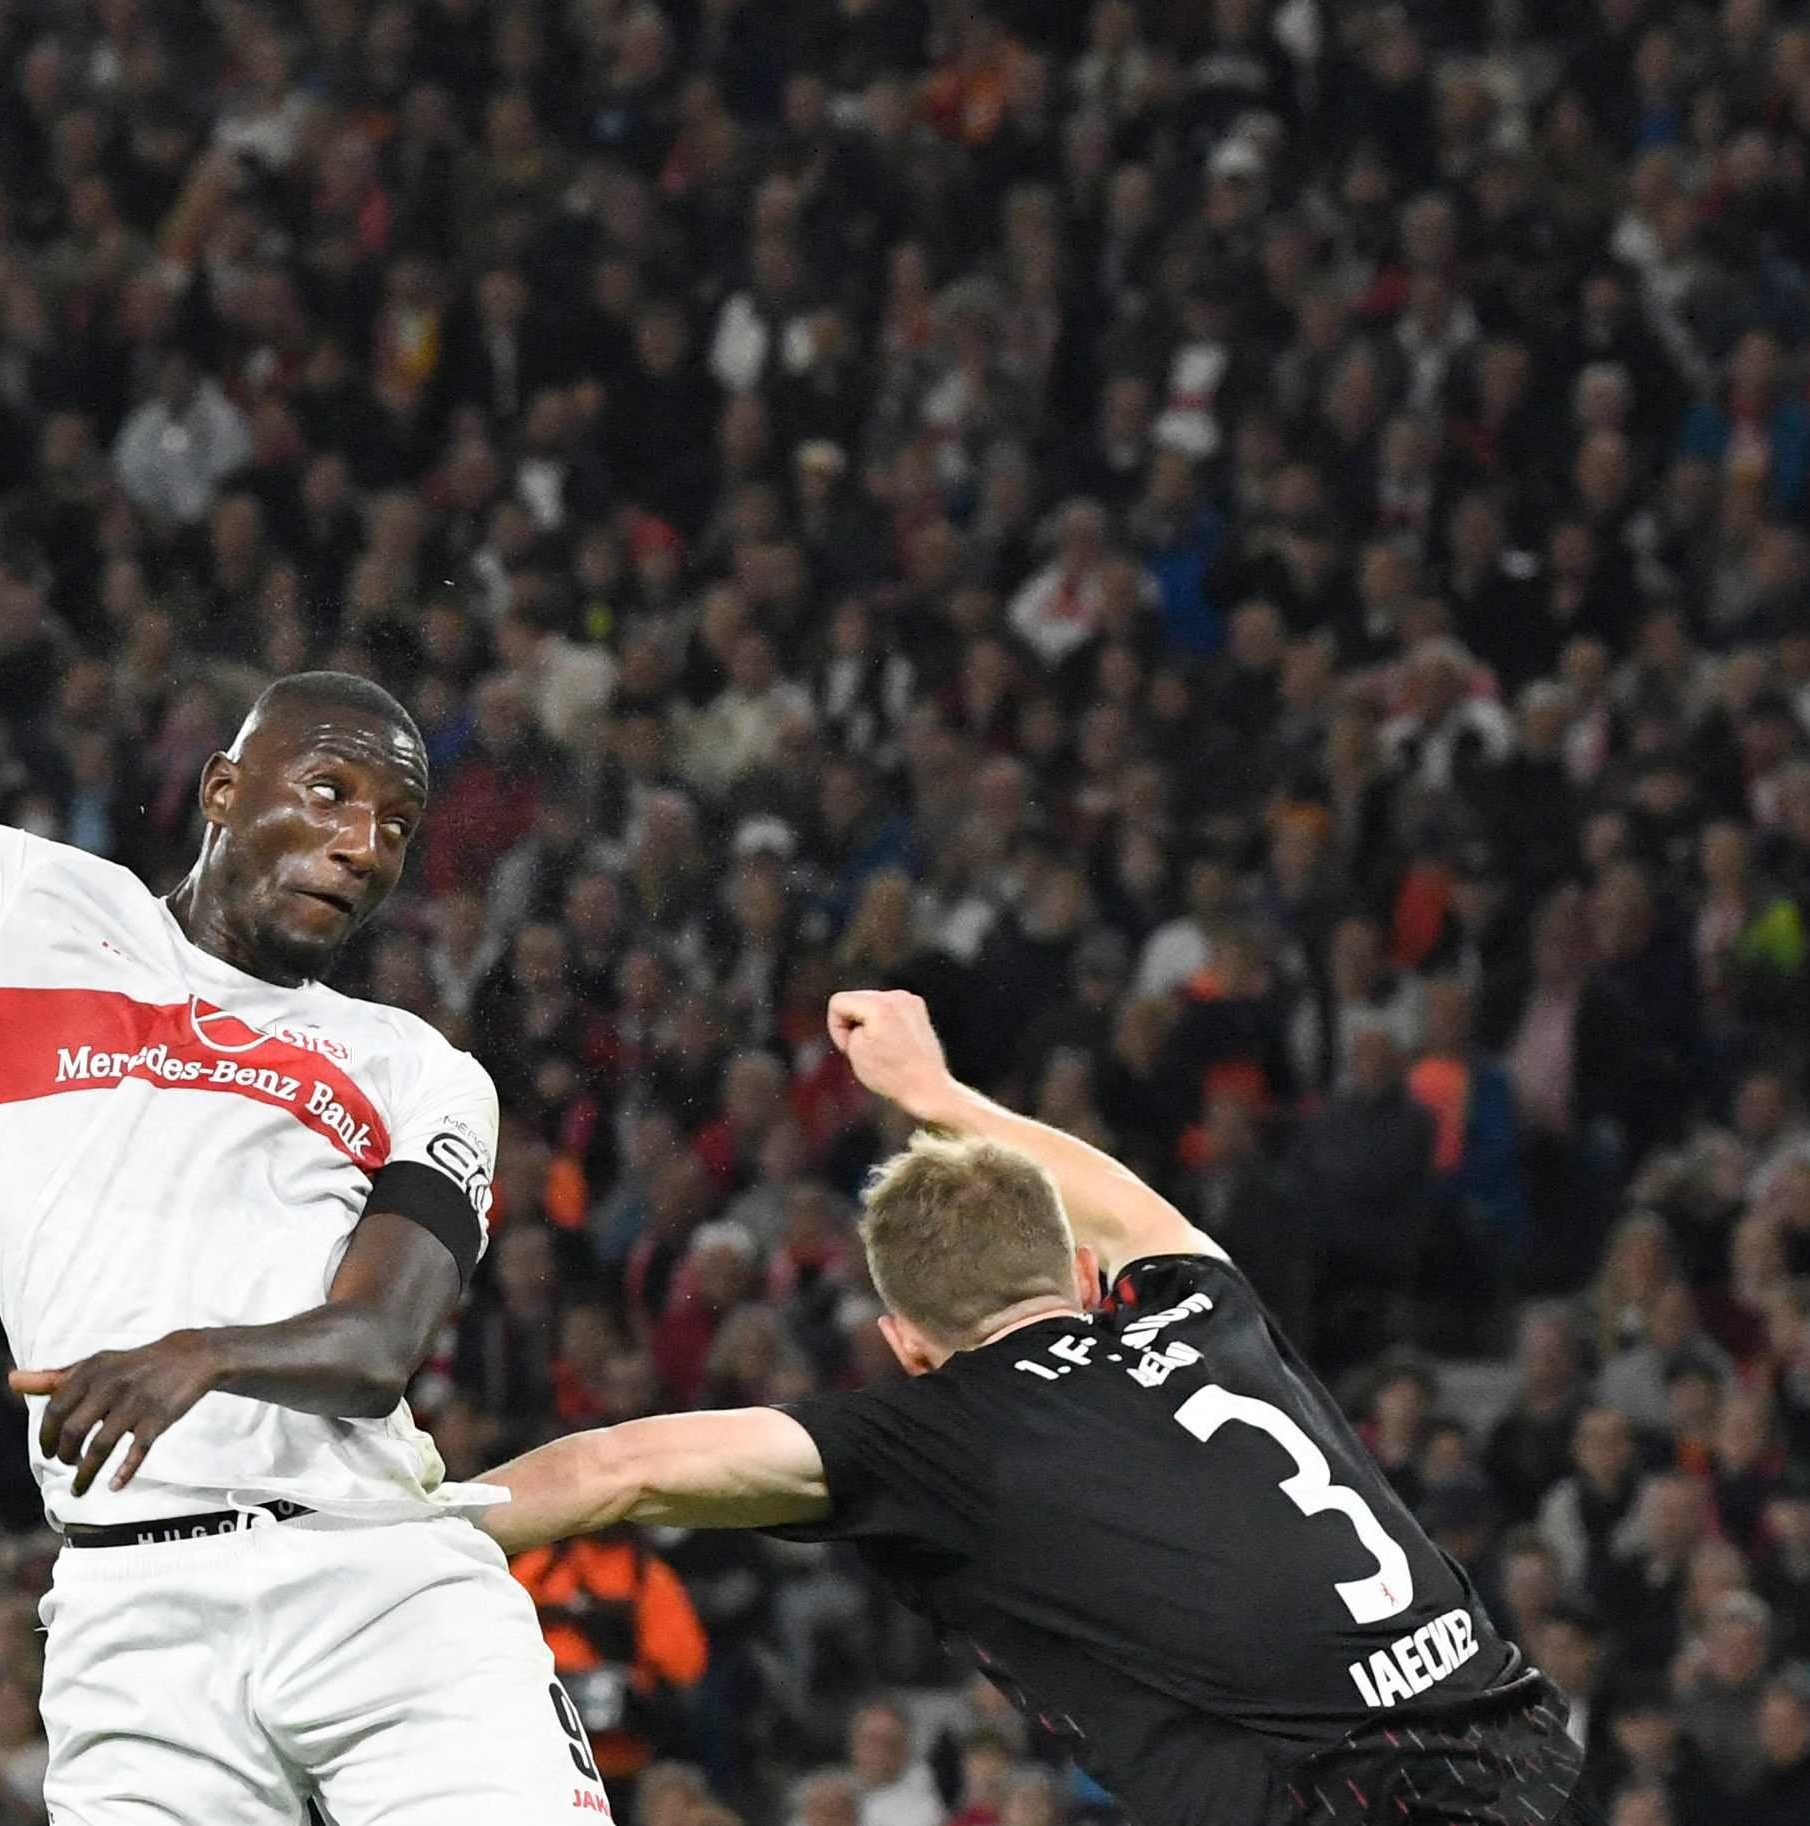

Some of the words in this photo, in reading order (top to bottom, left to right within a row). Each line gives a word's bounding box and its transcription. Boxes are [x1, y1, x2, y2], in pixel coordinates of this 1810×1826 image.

[304, 1080, 372, 1159] Bank
[137, 1519, 235, 1546] HUGO
[1173, 1384, 1414, 1625] 3
[548, 1682, 599, 1783] 9
[572, 1788, 611, 1818] JAK
